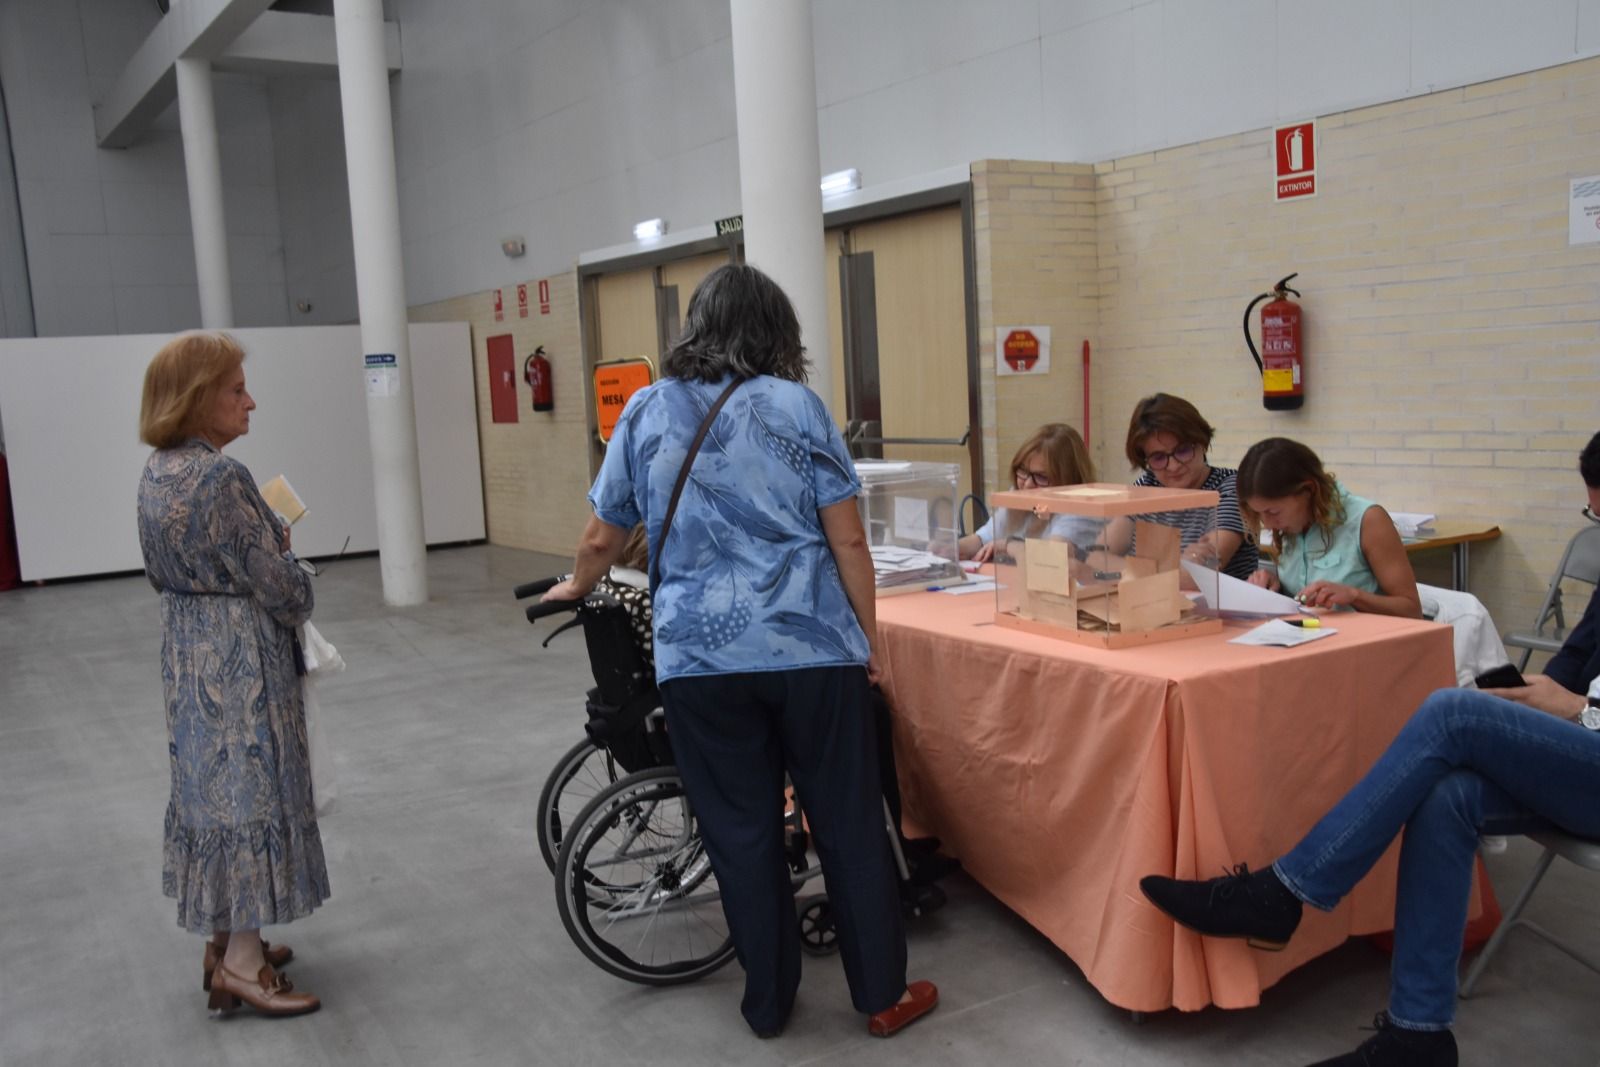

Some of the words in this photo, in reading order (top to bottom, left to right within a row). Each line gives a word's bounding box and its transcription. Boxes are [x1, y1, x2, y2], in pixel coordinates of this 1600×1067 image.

[1280, 181, 1312, 193] EXTINTOR
[719, 217, 742, 235] SALID
[602, 394, 624, 406] MESA
